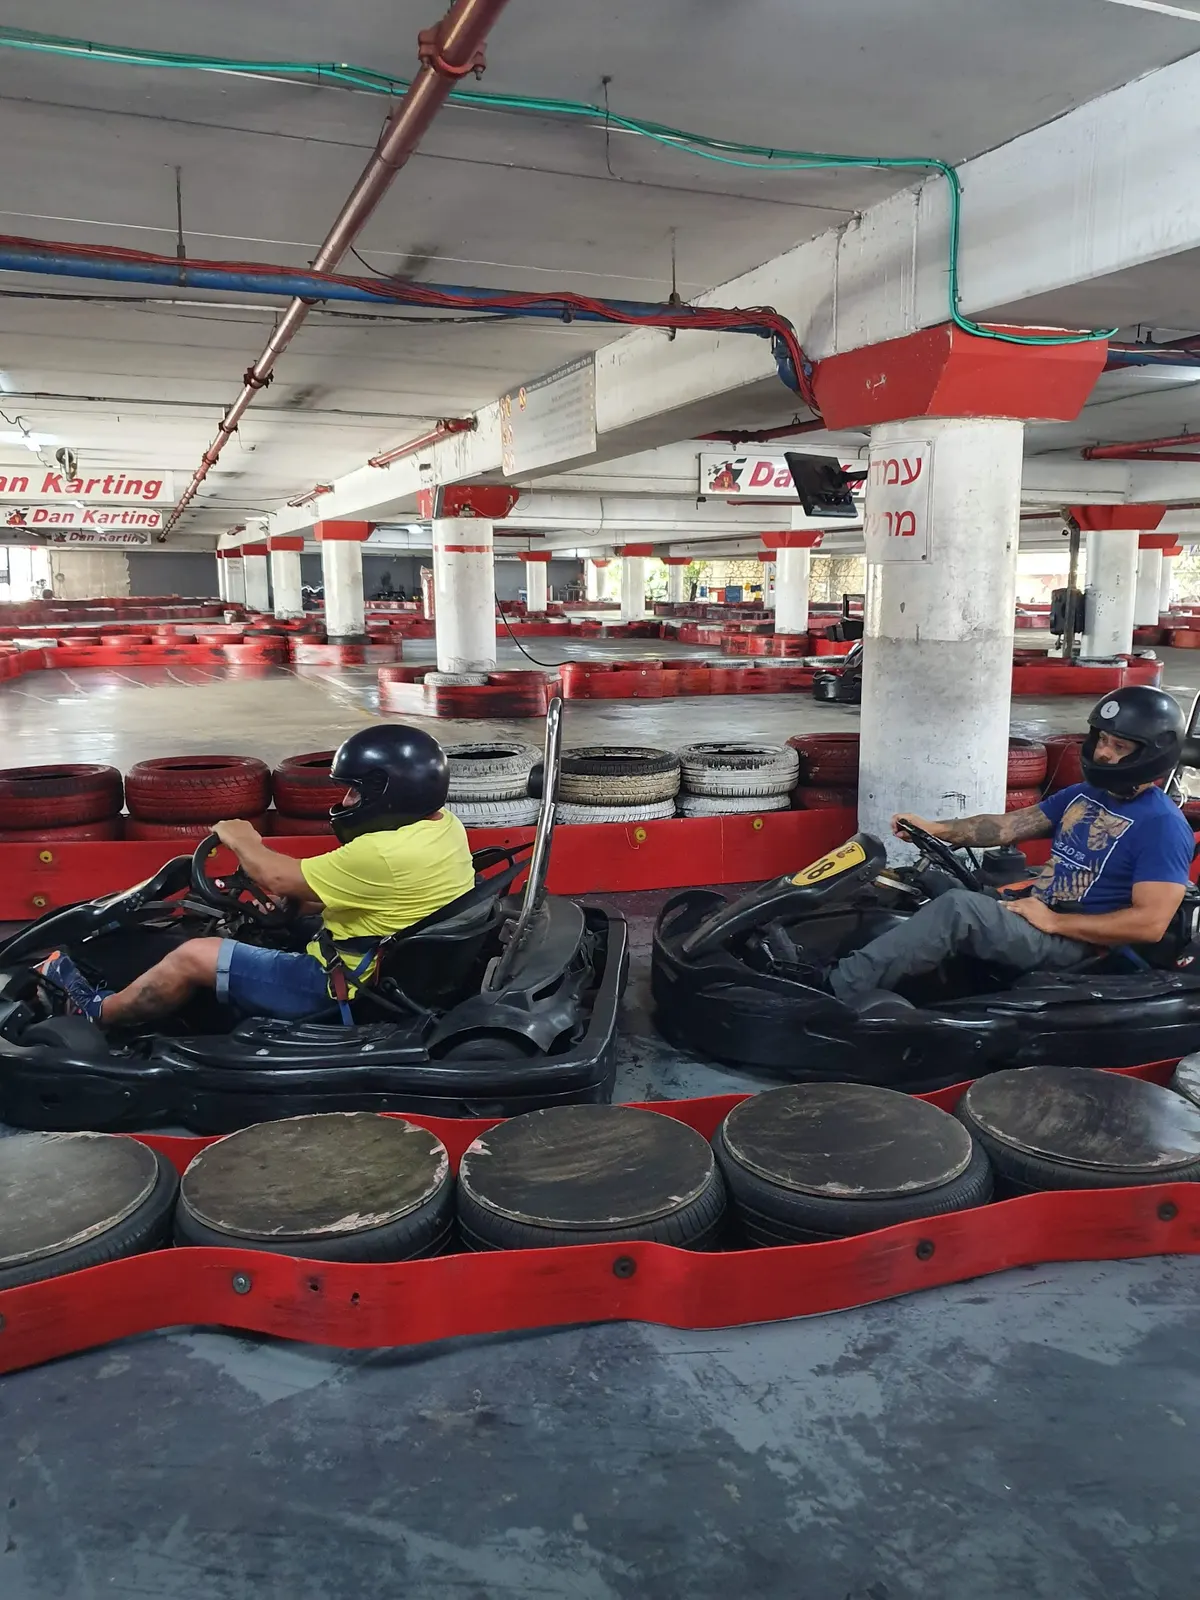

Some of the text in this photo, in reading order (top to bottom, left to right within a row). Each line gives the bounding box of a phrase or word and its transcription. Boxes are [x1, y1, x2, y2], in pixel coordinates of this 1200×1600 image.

[748, 461, 796, 488] Da
[869, 457, 922, 486] עמד
[0, 472, 163, 500] an Karting
[32, 509, 160, 527] Dan Karting
[865, 510, 916, 537] מרש
[69, 531, 141, 543] Dan Kartin
[802, 858, 836, 880] 18
